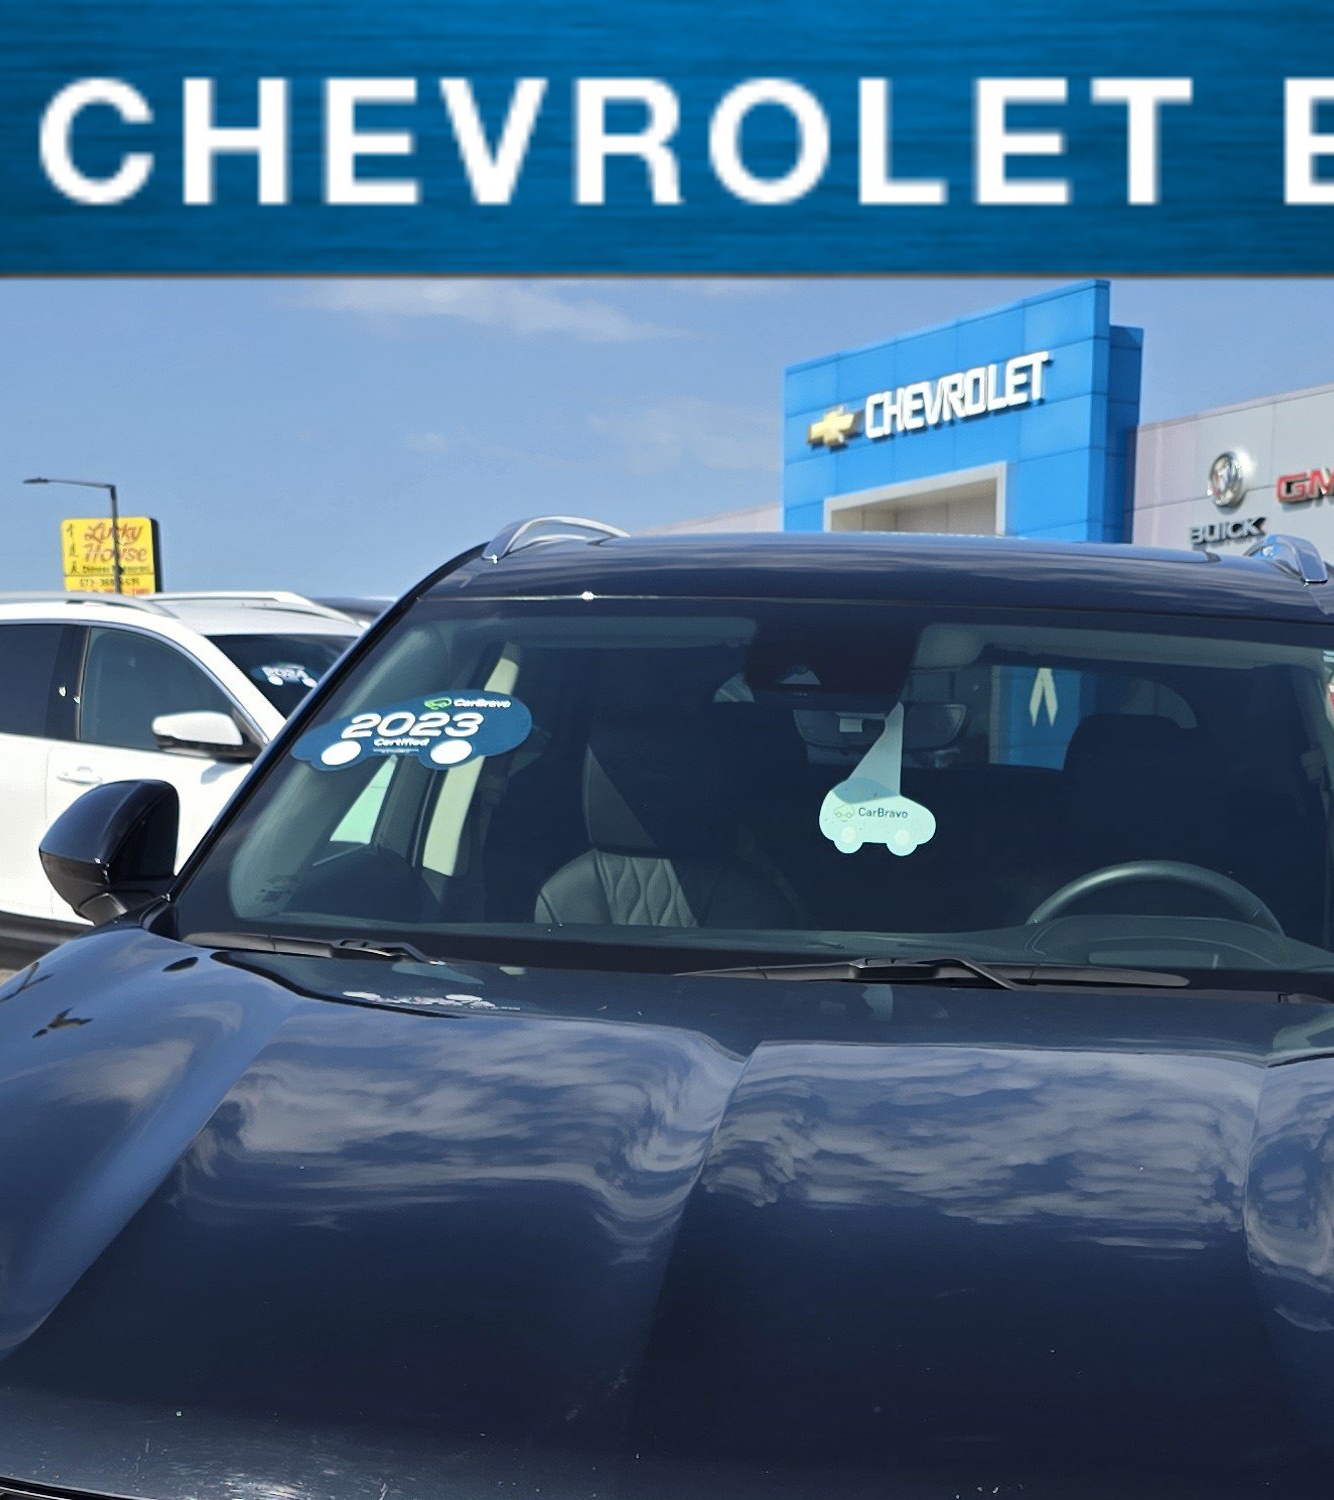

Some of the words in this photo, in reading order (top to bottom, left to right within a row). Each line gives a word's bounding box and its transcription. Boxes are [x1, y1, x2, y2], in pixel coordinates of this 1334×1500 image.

[865, 351, 1050, 439] CHEVROLET
[84, 522, 144, 545] Luky
[1190, 517, 1266, 545] BUICK
[340, 711, 485, 739] 2023
[373, 738, 430, 748] Certified
[857, 807, 909, 819] CarBravo
